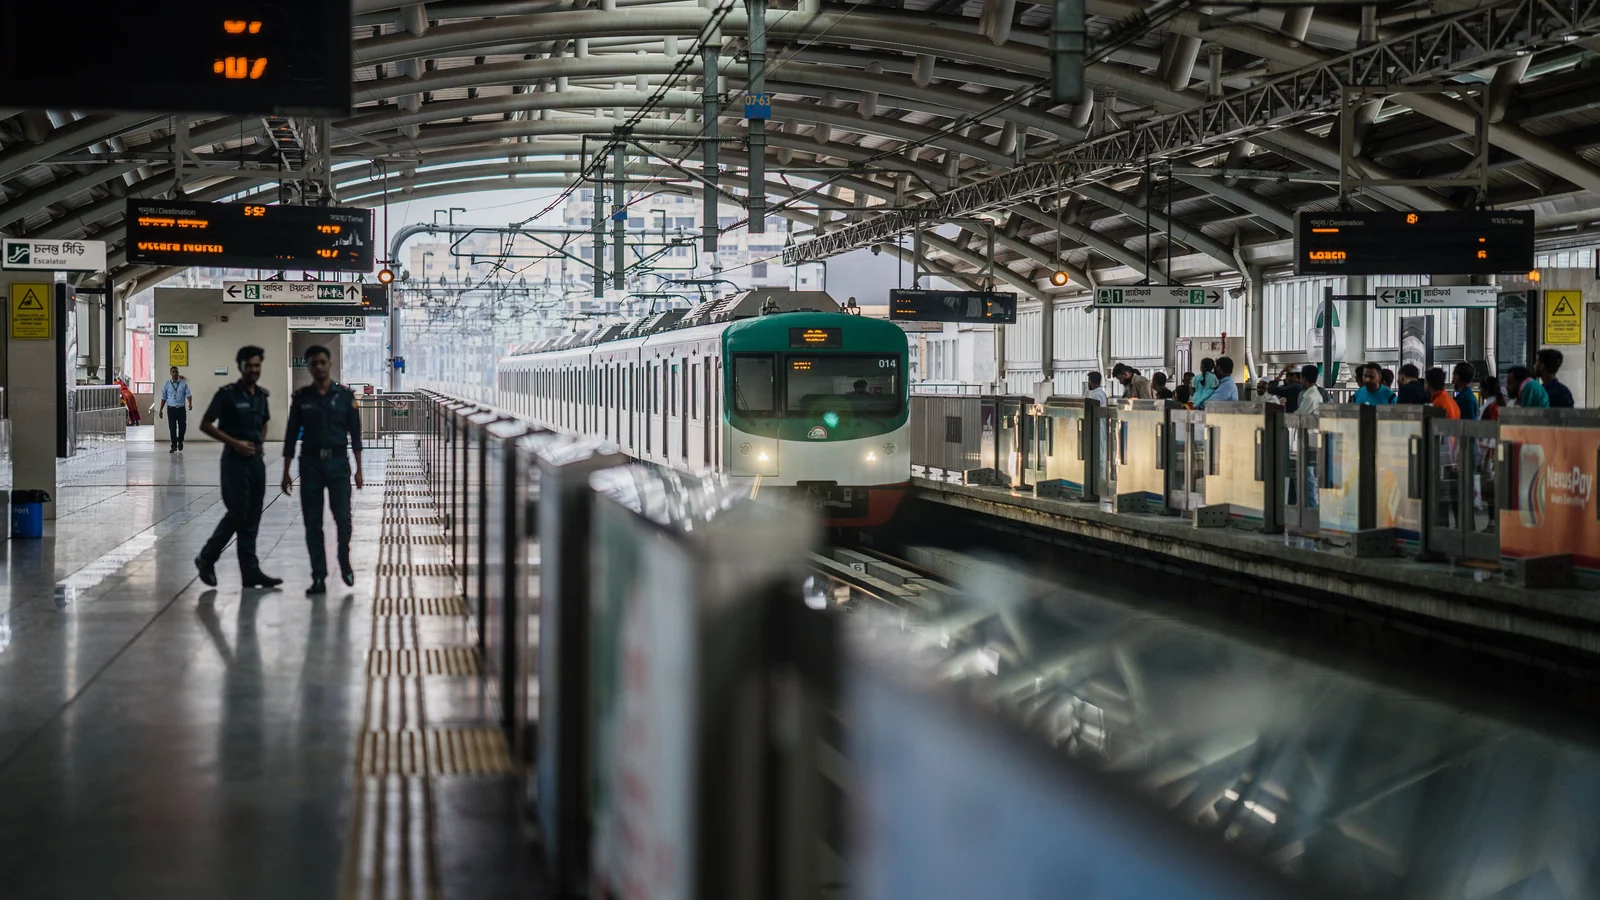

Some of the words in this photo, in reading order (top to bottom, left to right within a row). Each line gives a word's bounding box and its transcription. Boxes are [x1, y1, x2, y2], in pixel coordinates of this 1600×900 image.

[34, 244, 59, 255] চলন্ত
[33, 257, 67, 265] Escalator
[262, 283, 283, 292] বাহির
[289, 284, 315, 292] টয়লেট
[1170, 288, 1189, 297] বাহির
[345, 317, 352, 327] 2
[878, 359, 896, 368] 014
[1546, 463, 1593, 502] NexusPay
